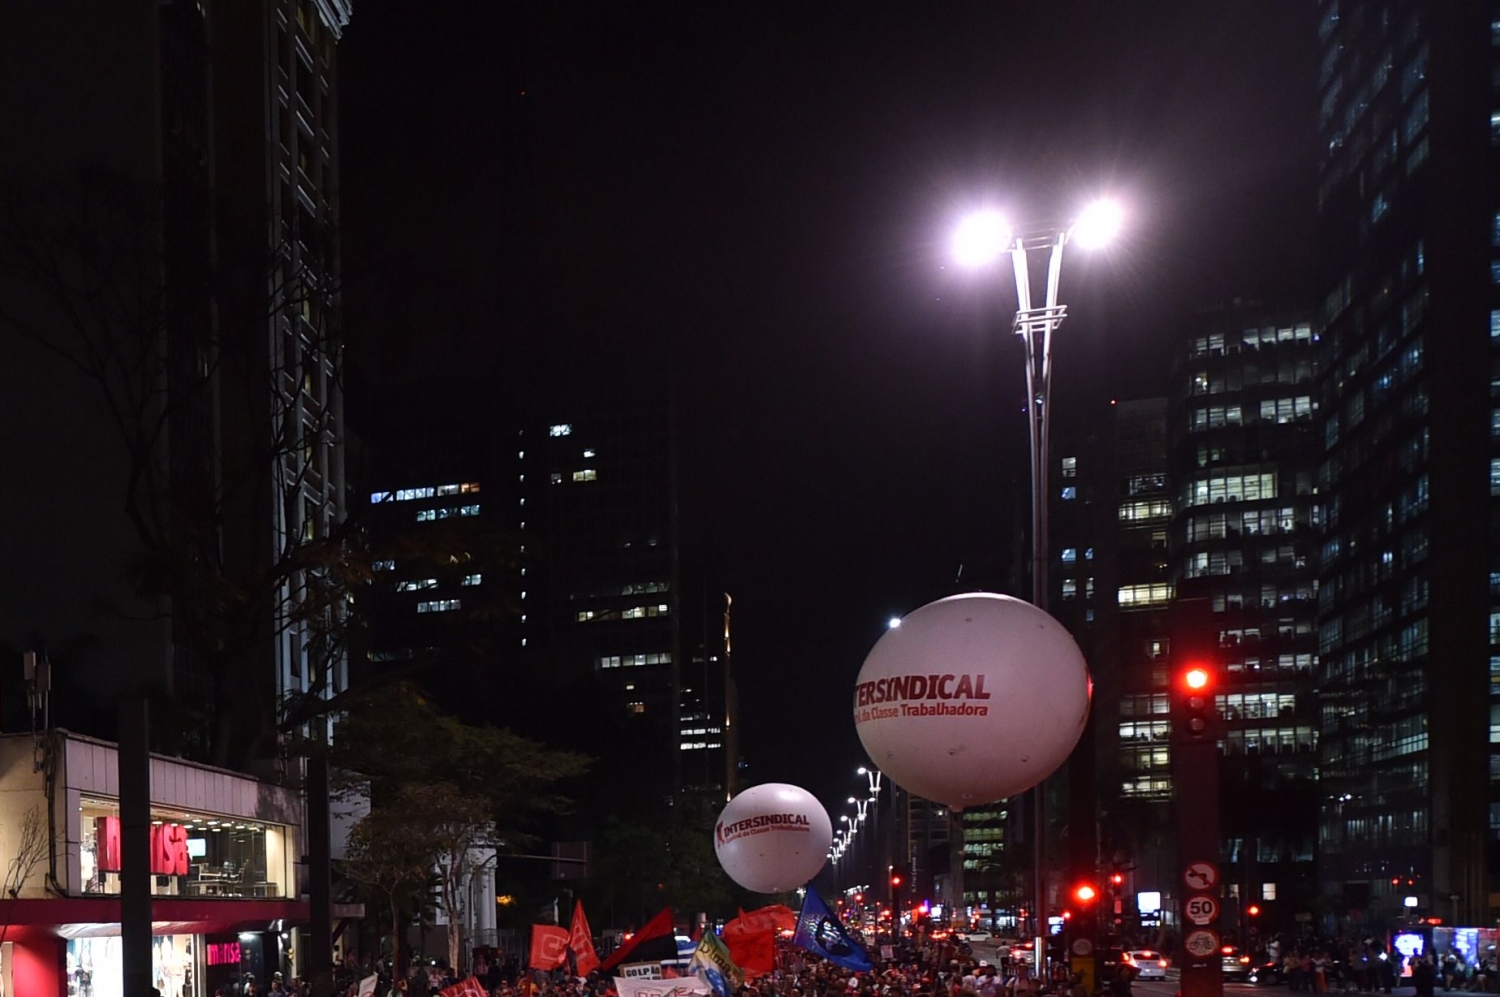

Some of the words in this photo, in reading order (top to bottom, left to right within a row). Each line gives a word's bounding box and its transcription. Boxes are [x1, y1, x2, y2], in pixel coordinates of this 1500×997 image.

[853, 674, 991, 709] TERSINDICAL
[871, 707, 899, 720] Classe
[901, 701, 988, 716] Trabalhadora
[723, 814, 810, 837] INTERSINDICAL
[1190, 901, 1212, 915] 50
